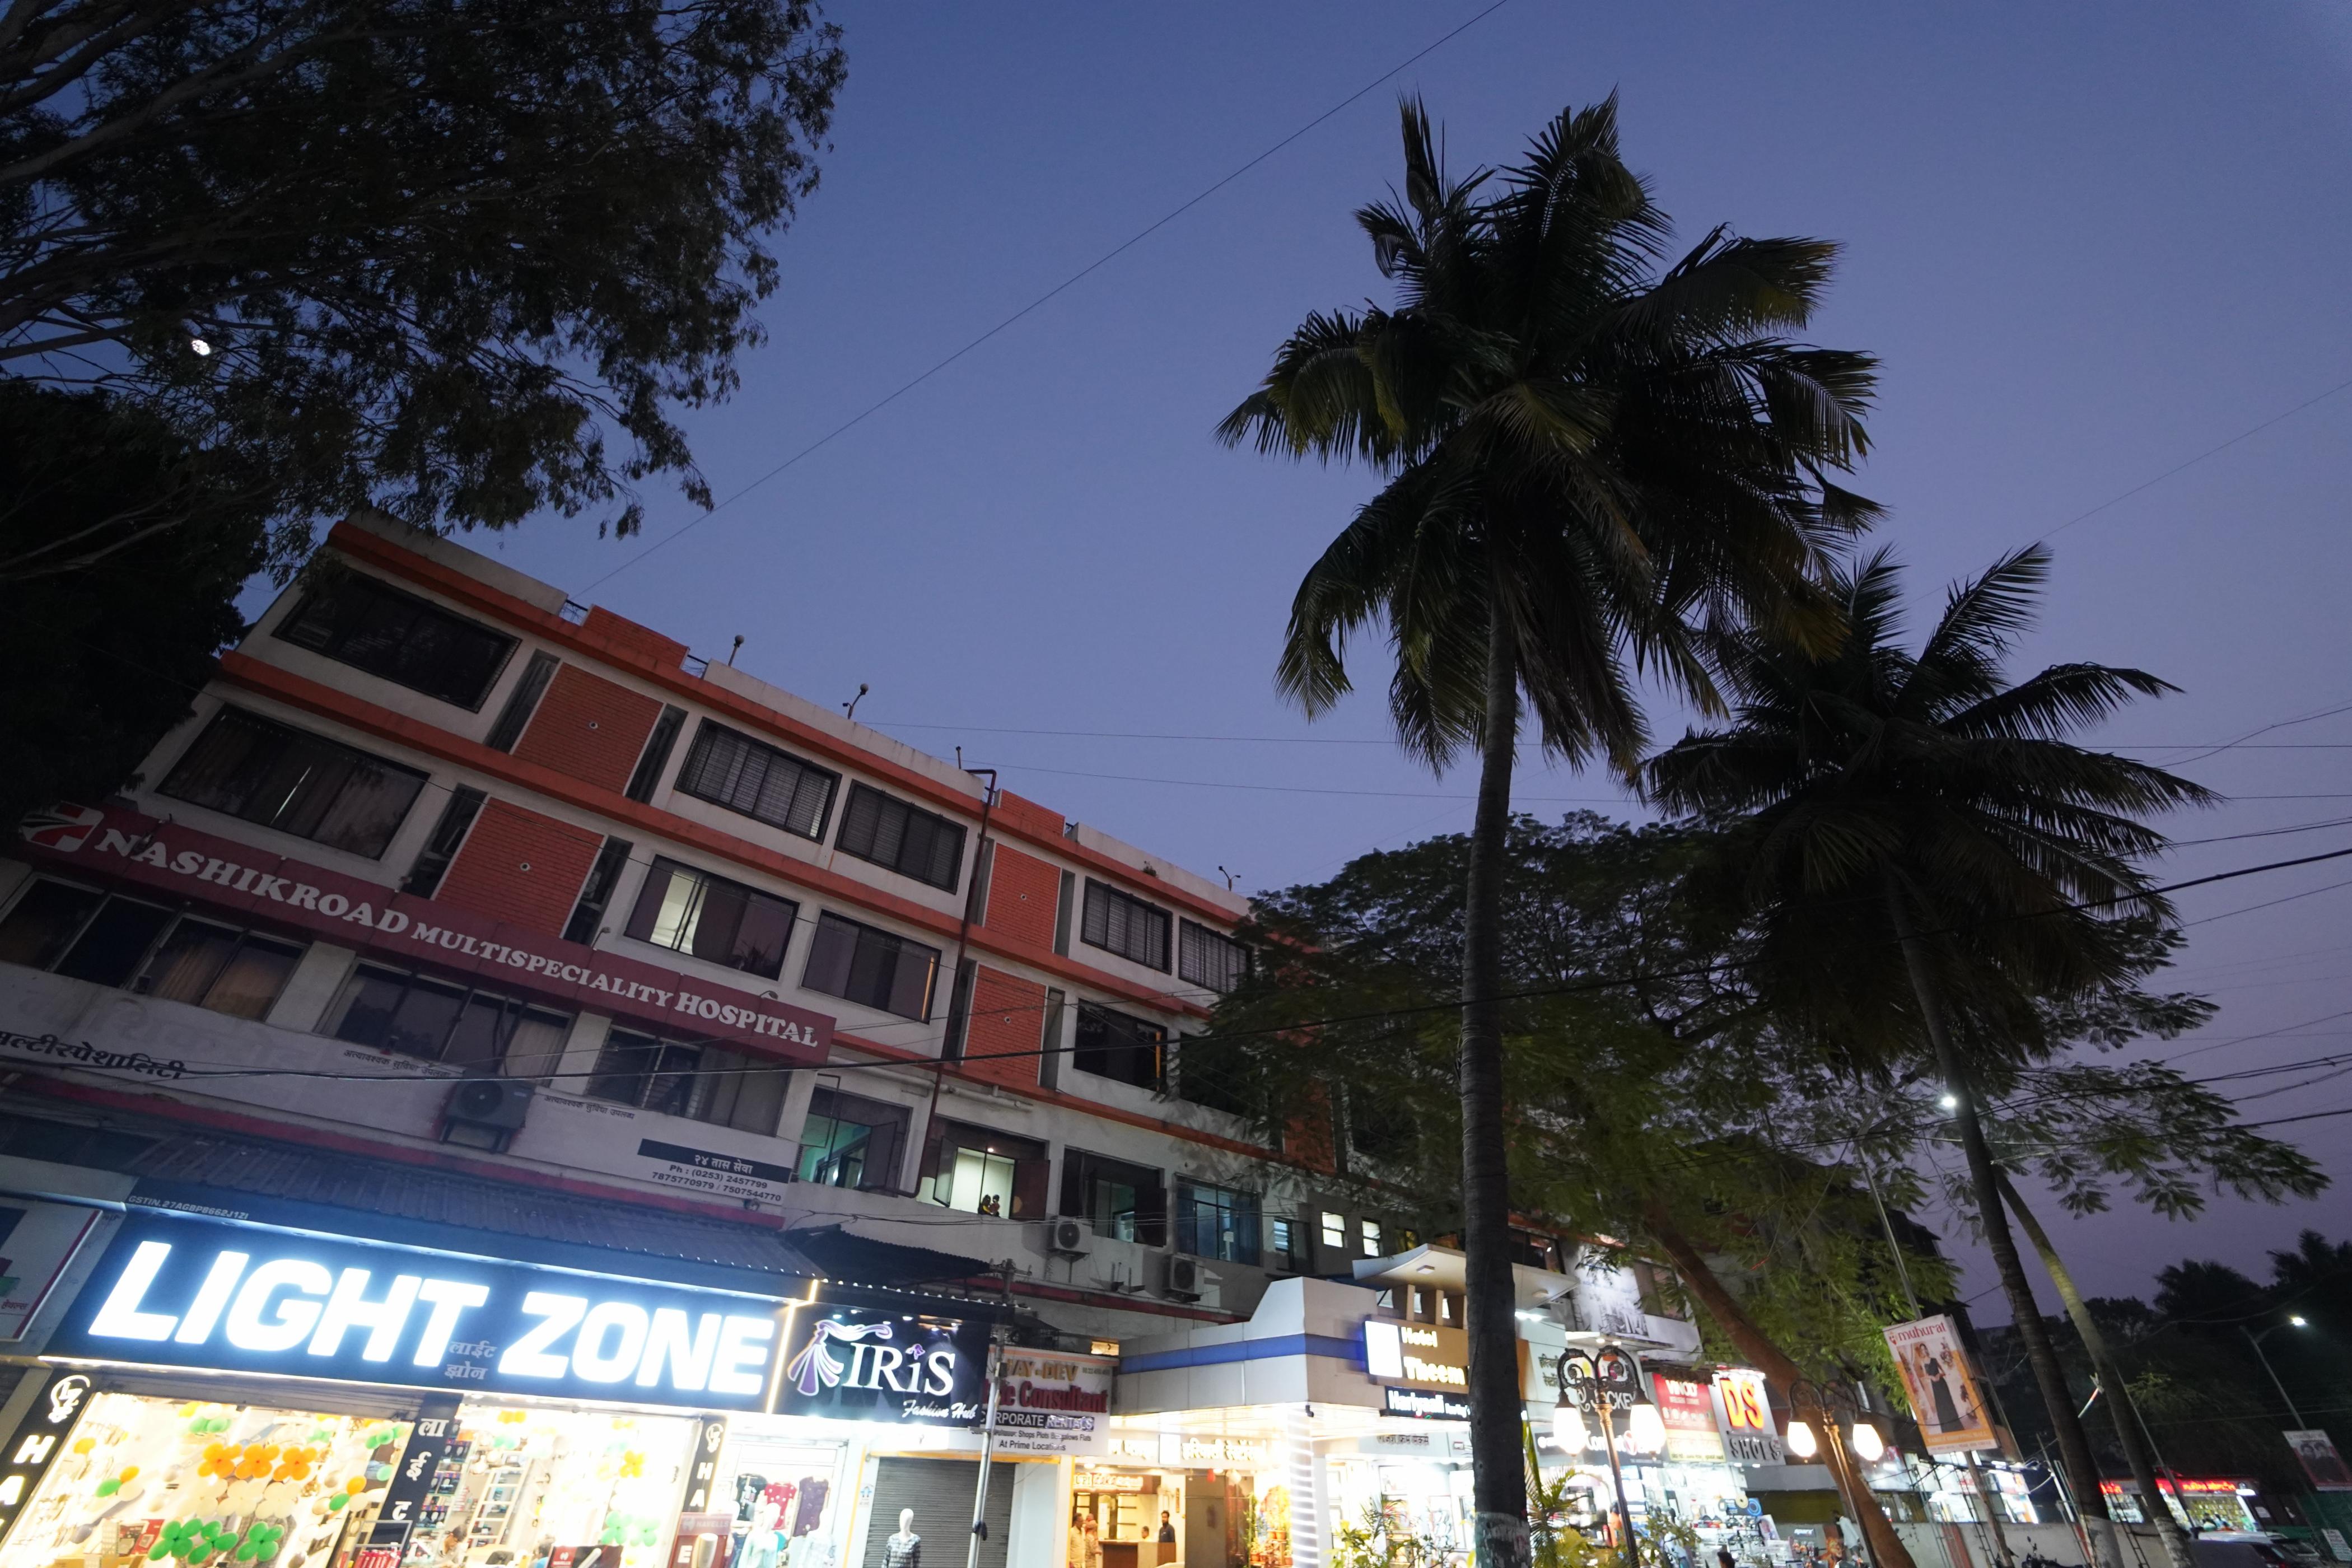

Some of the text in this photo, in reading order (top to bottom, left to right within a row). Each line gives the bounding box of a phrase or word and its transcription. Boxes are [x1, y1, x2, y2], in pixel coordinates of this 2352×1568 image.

[94, 828, 818, 1047] NASHIKROAD MULTISPECIALITY HOSPITAL
[694, 1154, 754, 1175] २४ तास सेवा
[652, 1172, 715, 1190] 7875770979
[723, 1184, 782, 1202] 7507544770
[669, 1165, 683, 1173] Ph
[692, 1168, 724, 1182] (0253)
[726, 1175, 768, 1189] 2457799
[87, 1240, 775, 1395] LIGHT ZONE
[1401, 1327, 1438, 1347] Hotel
[1898, 1321, 1947, 1342] muhurat
[449, 1340, 498, 1359] लाईट
[444, 1361, 489, 1380] झोन
[1019, 1380, 1109, 1413] Consultant
[1719, 1378, 1765, 1430] DS
[901, 1399, 978, 1419] Fashion Hub
[1009, 1441, 1030, 1449] Prime
